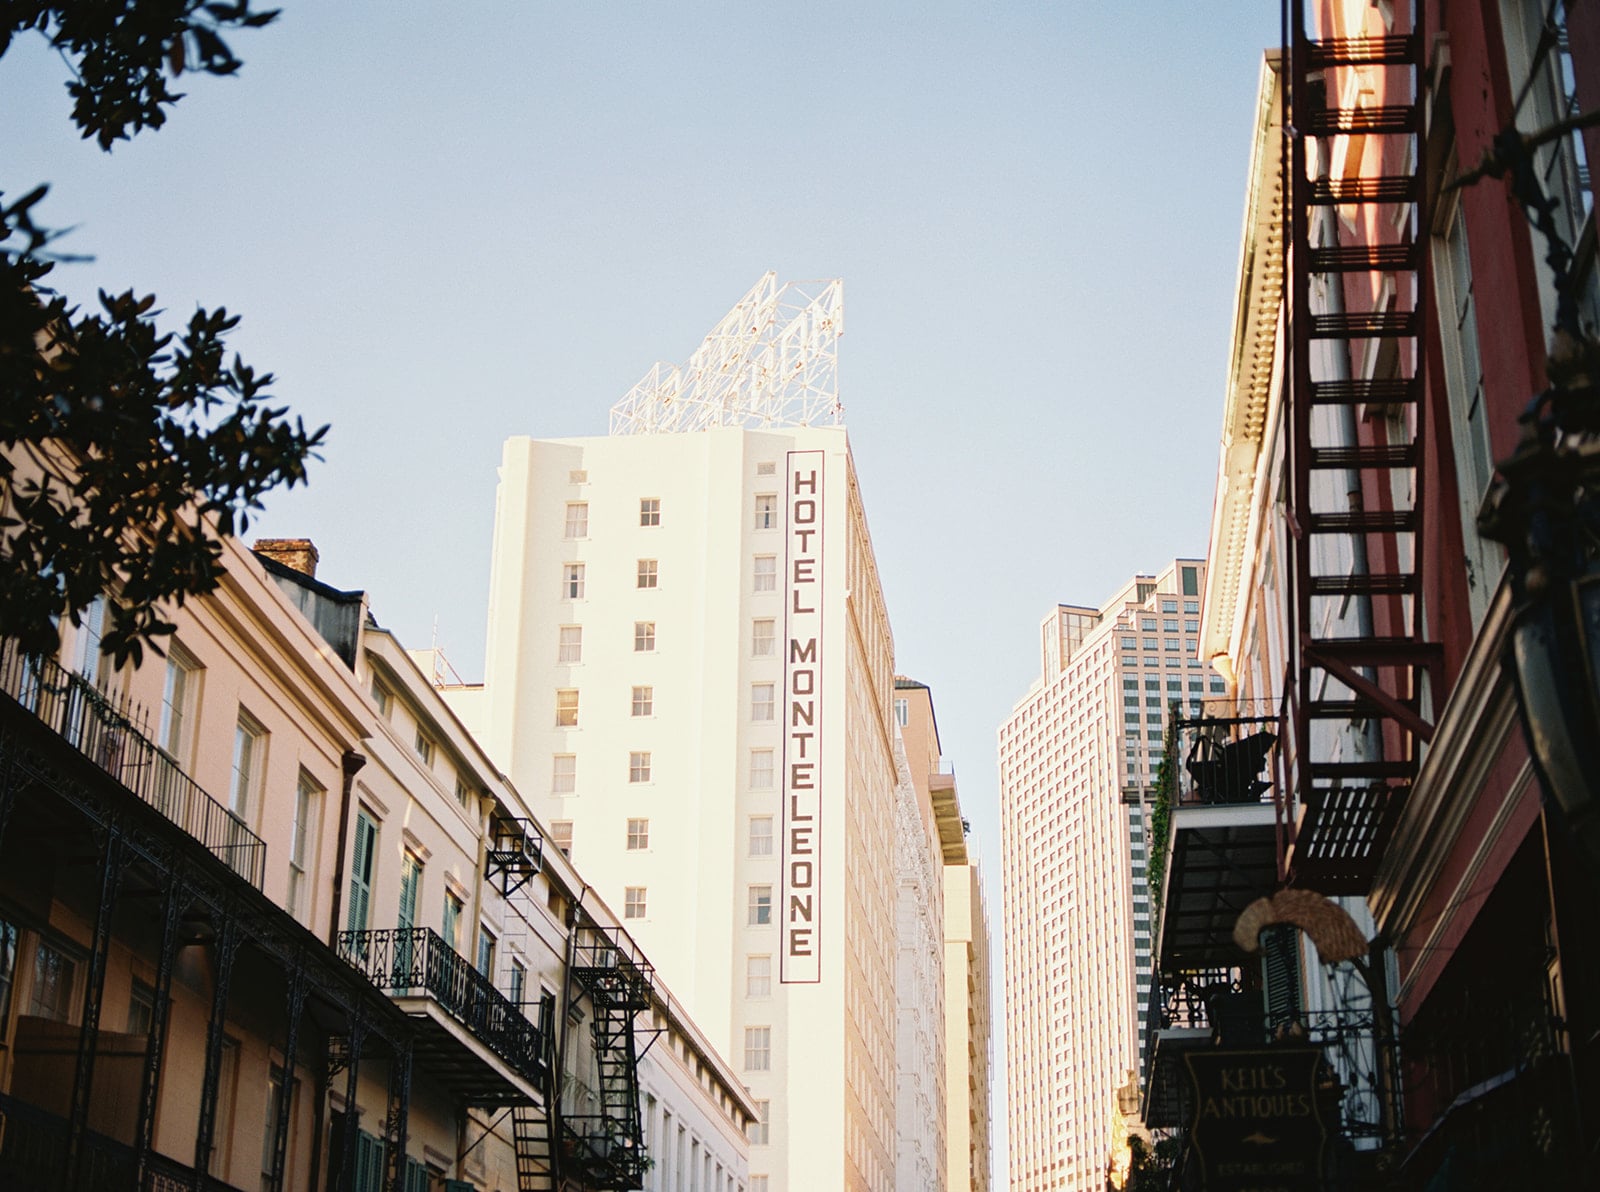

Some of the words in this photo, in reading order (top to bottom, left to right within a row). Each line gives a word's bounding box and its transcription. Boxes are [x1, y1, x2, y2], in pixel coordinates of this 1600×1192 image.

[794, 470, 816, 613] HOTEL
[790, 638, 816, 956] MONTELEONE
[1205, 1095, 1310, 1119] ANTIQUES
[1222, 1065, 1286, 1090] KEIL'S
